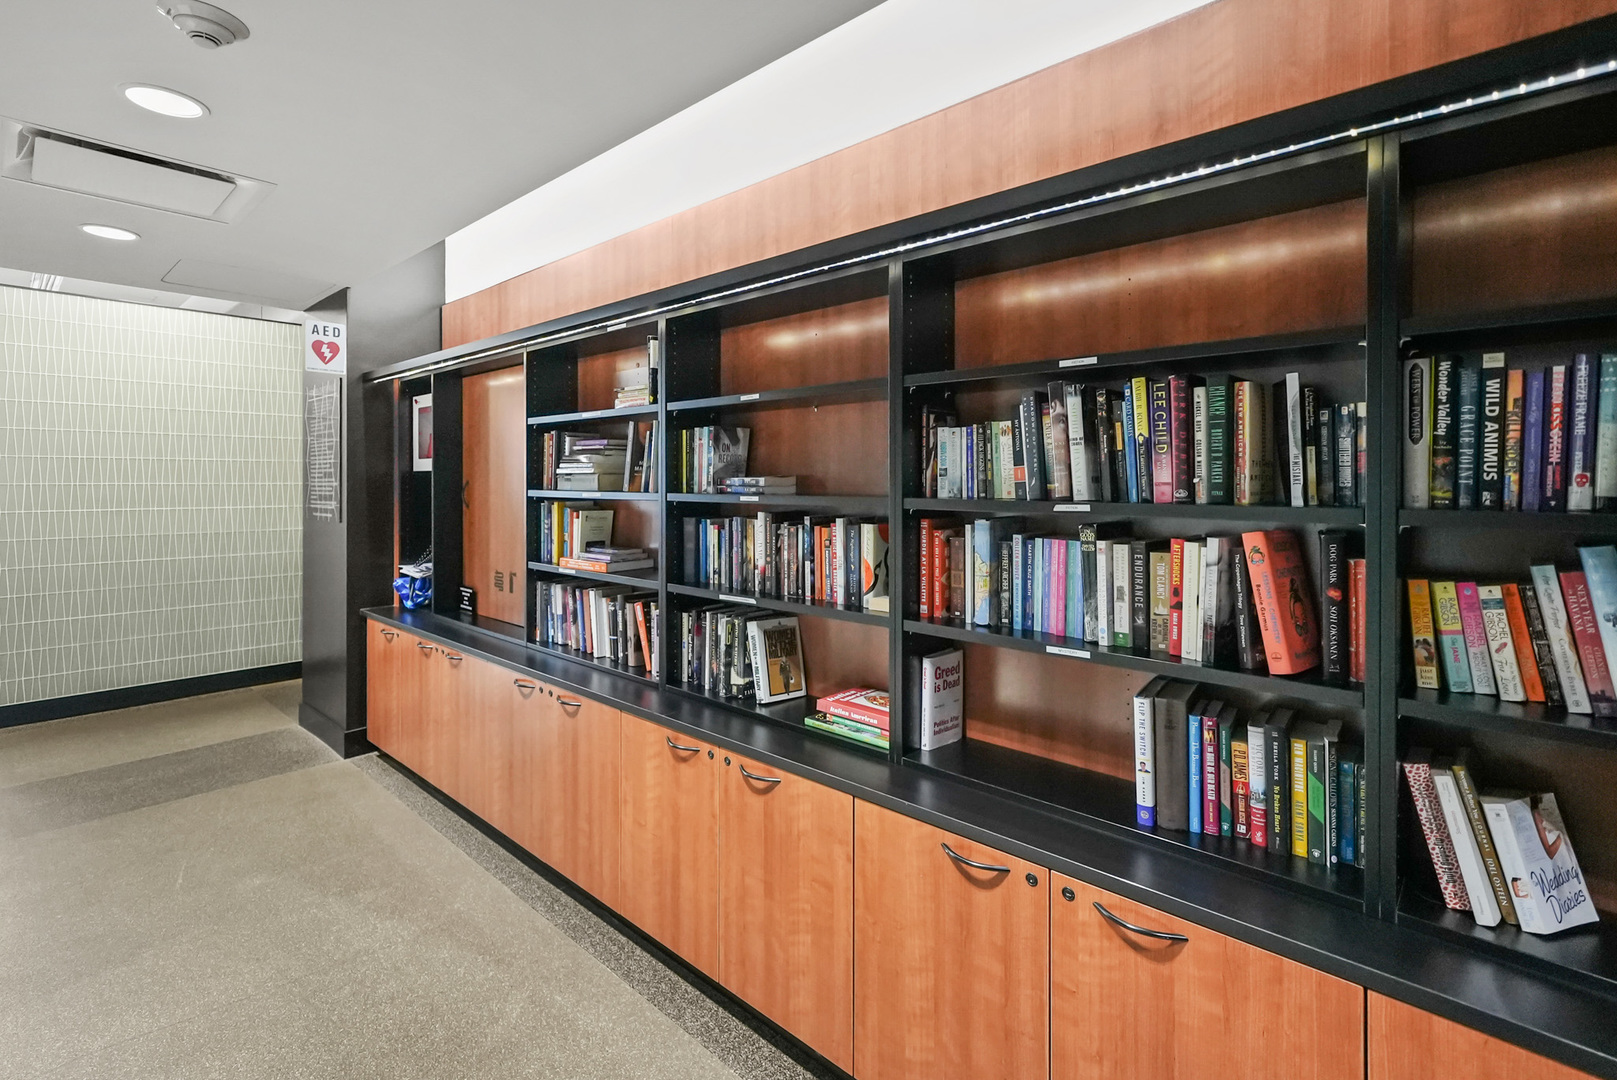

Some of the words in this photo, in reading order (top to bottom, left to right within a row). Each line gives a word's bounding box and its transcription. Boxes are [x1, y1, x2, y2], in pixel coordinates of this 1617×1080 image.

[311, 324, 341, 338] AED
[1411, 370, 1422, 393] WEBS
[1438, 361, 1453, 402] Wonder
[1575, 365, 1589, 400] FREEZE
[1153, 383, 1167, 409] LEE
[1179, 380, 1187, 420] DARK
[1209, 386, 1226, 417] CHANGE
[1485, 379, 1500, 417] WILD
[1044, 422, 1053, 440] ENTER
[1126, 416, 1134, 437] GAMES
[1410, 406, 1421, 440] POWER
[1433, 404, 1451, 436] Valley
[1459, 405, 1475, 444] GRACE
[1507, 410, 1522, 437] KILL
[1574, 402, 1587, 436] FRAME
[1155, 411, 1168, 454] CHILD
[1238, 420, 1246, 458] AMERICAN
[721, 442, 731, 453] ON
[1179, 431, 1188, 481] DEBTS
[1483, 421, 1499, 481] ANIMUS
[1210, 461, 1223, 484] PARKER
[1291, 461, 1302, 486] MISTAKE
[1458, 449, 1474, 486] POINT
[921, 557, 927, 565] AT
[1172, 544, 1182, 585] AFTERSHOCKS
[1329, 544, 1338, 561] DOG
[921, 567, 927, 575] LA
[1134, 553, 1144, 608] ENDURANCE
[1156, 562, 1166, 576] TOM
[1329, 563, 1338, 584] PARK
[1156, 576, 1166, 600] CLANCY
[1255, 583, 1264, 606] Bonnie
[1259, 606, 1270, 632] Garmus
[1262, 571, 1273, 600] LESSONS
[1269, 608, 1282, 644] CHEMISTRY
[1330, 605, 1338, 622] SOFI
[1412, 606, 1423, 635] GIBSON
[1438, 597, 1450, 626] GIBSON
[1447, 597, 1460, 626] RACHEL
[1549, 606, 1562, 631] Perfect
[1568, 595, 1584, 632] HAVANA
[1575, 583, 1588, 605] NEXT
[1582, 609, 1596, 635] YEAR
[1421, 607, 1432, 635] RACHEL
[1463, 615, 1477, 649] GIBSON
[1472, 614, 1486, 649] RACHEL
[1484, 611, 1498, 642] GIBSON
[1495, 611, 1509, 641] RACHEL
[750, 634, 758, 656] WOMEN
[1330, 624, 1339, 660] OKSANEN
[1450, 646, 1461, 664] JANE
[934, 660, 960, 681] Greed
[1471, 651, 1481, 673] ABOUT
[1478, 651, 1486, 669] WHAT
[1496, 657, 1508, 674] For
[934, 681, 941, 694] is
[942, 674, 960, 692] Dead
[1499, 676, 1511, 697] Love
[1138, 701, 1146, 716] FLIP
[933, 718, 950, 729] Politics
[1139, 731, 1147, 757] SWITCH
[1294, 743, 1304, 755] BEN
[1234, 760, 1248, 780] JAMES
[1294, 757, 1304, 793] MACINTYRE
[1330, 754, 1338, 770] SIGN
[1207, 784, 1216, 800] DEATH
[1273, 785, 1280, 794] No
[1295, 800, 1304, 819] AGENT
[1295, 821, 1304, 842] SONYA
[1467, 794, 1476, 813] Better
[1476, 821, 1490, 852] JOURNAL
[1485, 858, 1498, 875] JOEL
[1492, 876, 1509, 907] OSTEEN
[1530, 865, 1582, 897] Wedding
[1545, 889, 1587, 924] Diaries
